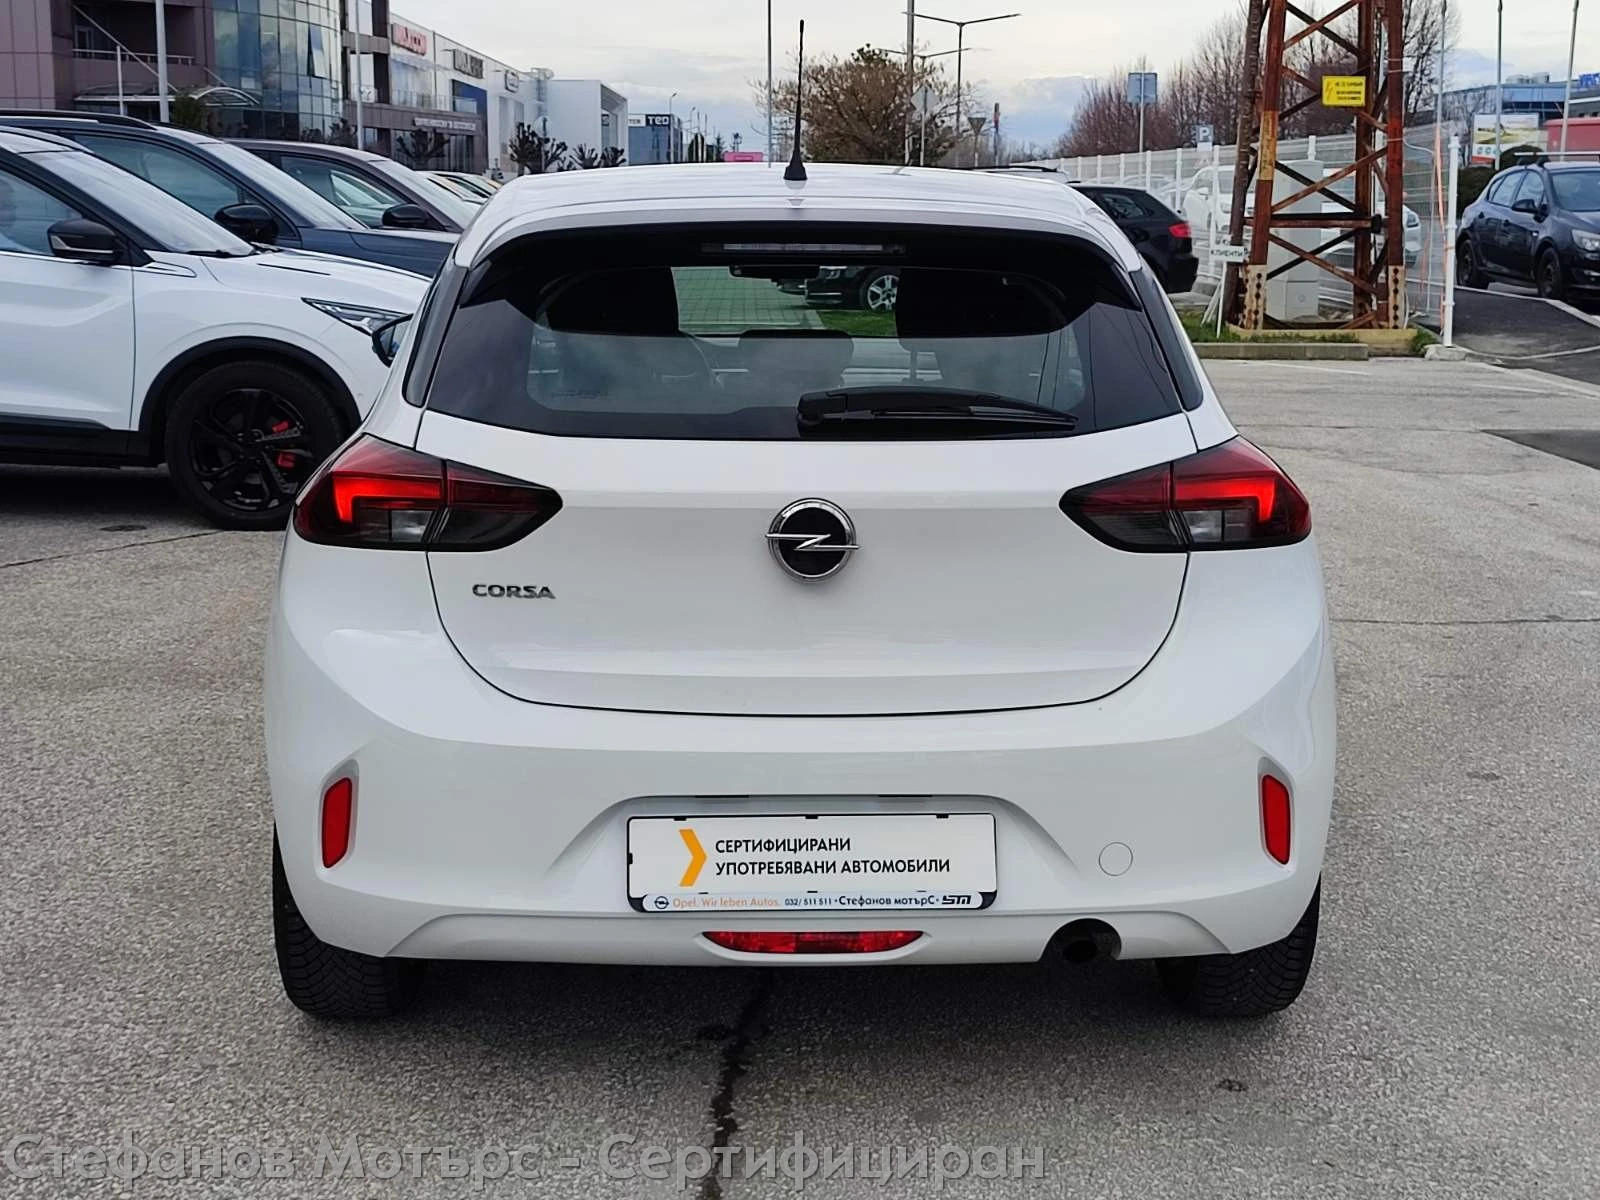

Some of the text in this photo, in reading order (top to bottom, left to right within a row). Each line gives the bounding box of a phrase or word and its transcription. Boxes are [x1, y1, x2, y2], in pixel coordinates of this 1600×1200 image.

[472, 584, 556, 599] CORSA
[715, 838, 851, 853] СЕРТИФИЦИРАНИ
[716, 859, 950, 875] УПОТРЕБЯВАНИ АВТОМОБИЛИ
[702, 897, 718, 906] Wir
[720, 897, 748, 905] leben
[818, 897, 832, 905] 511
